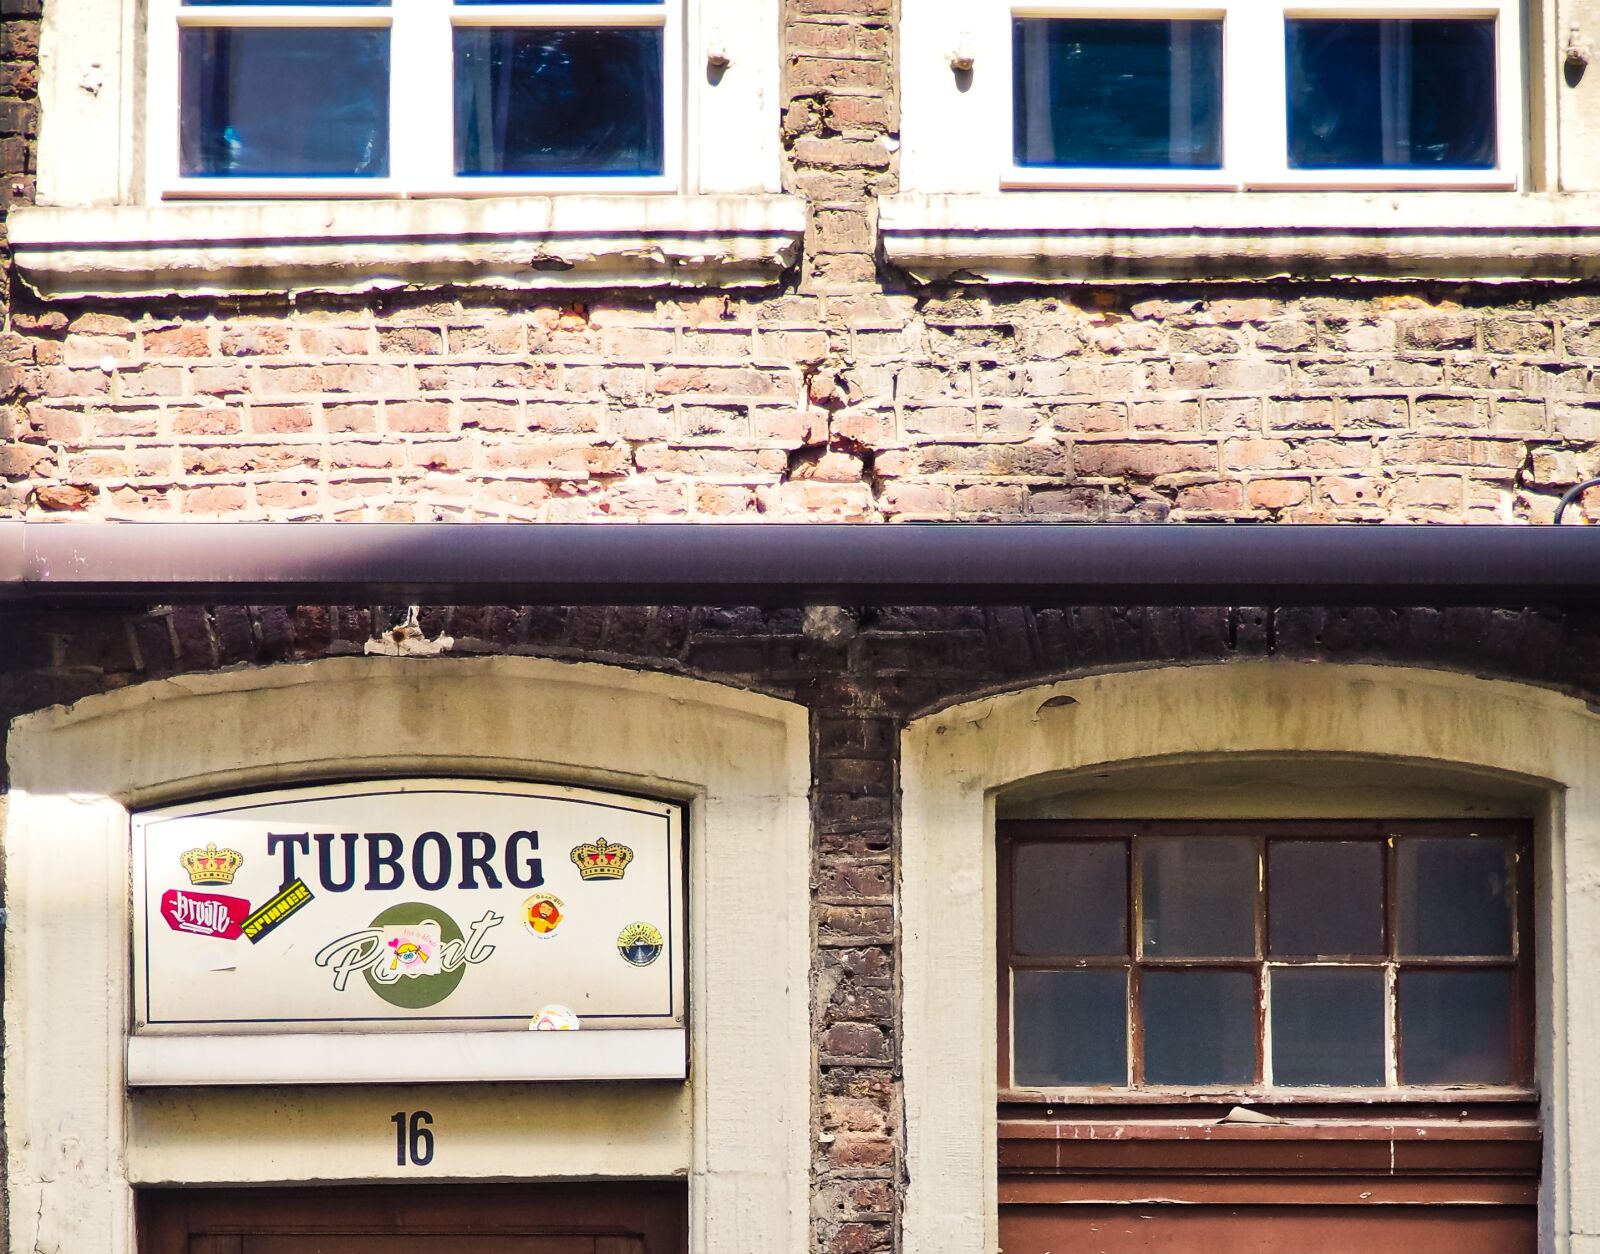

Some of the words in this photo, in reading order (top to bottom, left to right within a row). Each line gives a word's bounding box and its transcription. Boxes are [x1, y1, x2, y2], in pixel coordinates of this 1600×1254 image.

[267, 830, 544, 892] TUBORG
[244, 886, 310, 938] SPINNER
[390, 1111, 434, 1166] 16
